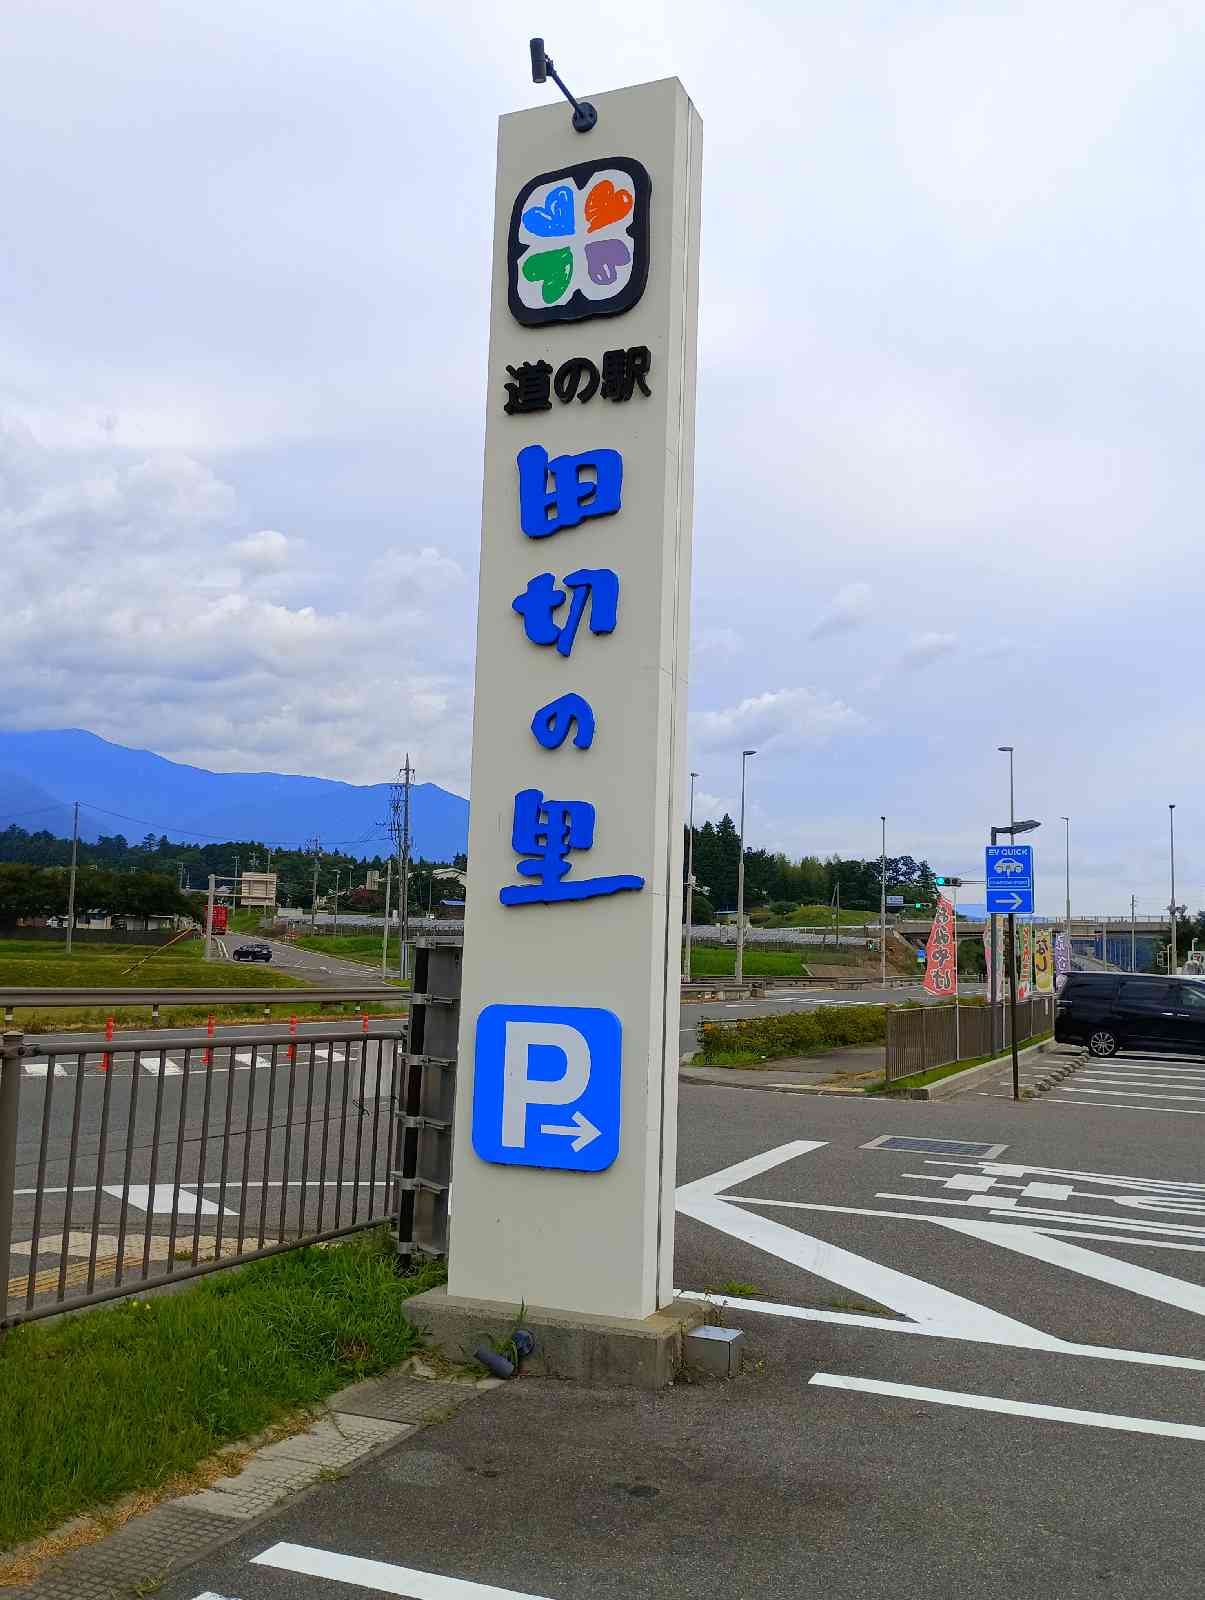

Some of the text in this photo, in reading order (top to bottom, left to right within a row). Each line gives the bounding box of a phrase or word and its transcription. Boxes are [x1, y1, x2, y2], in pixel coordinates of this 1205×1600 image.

[504, 346, 652, 415] 道の駅
[499, 444, 645, 905] 田切の里
[1002, 848, 1028, 856] QUICK
[502, 1021, 591, 1148] P
